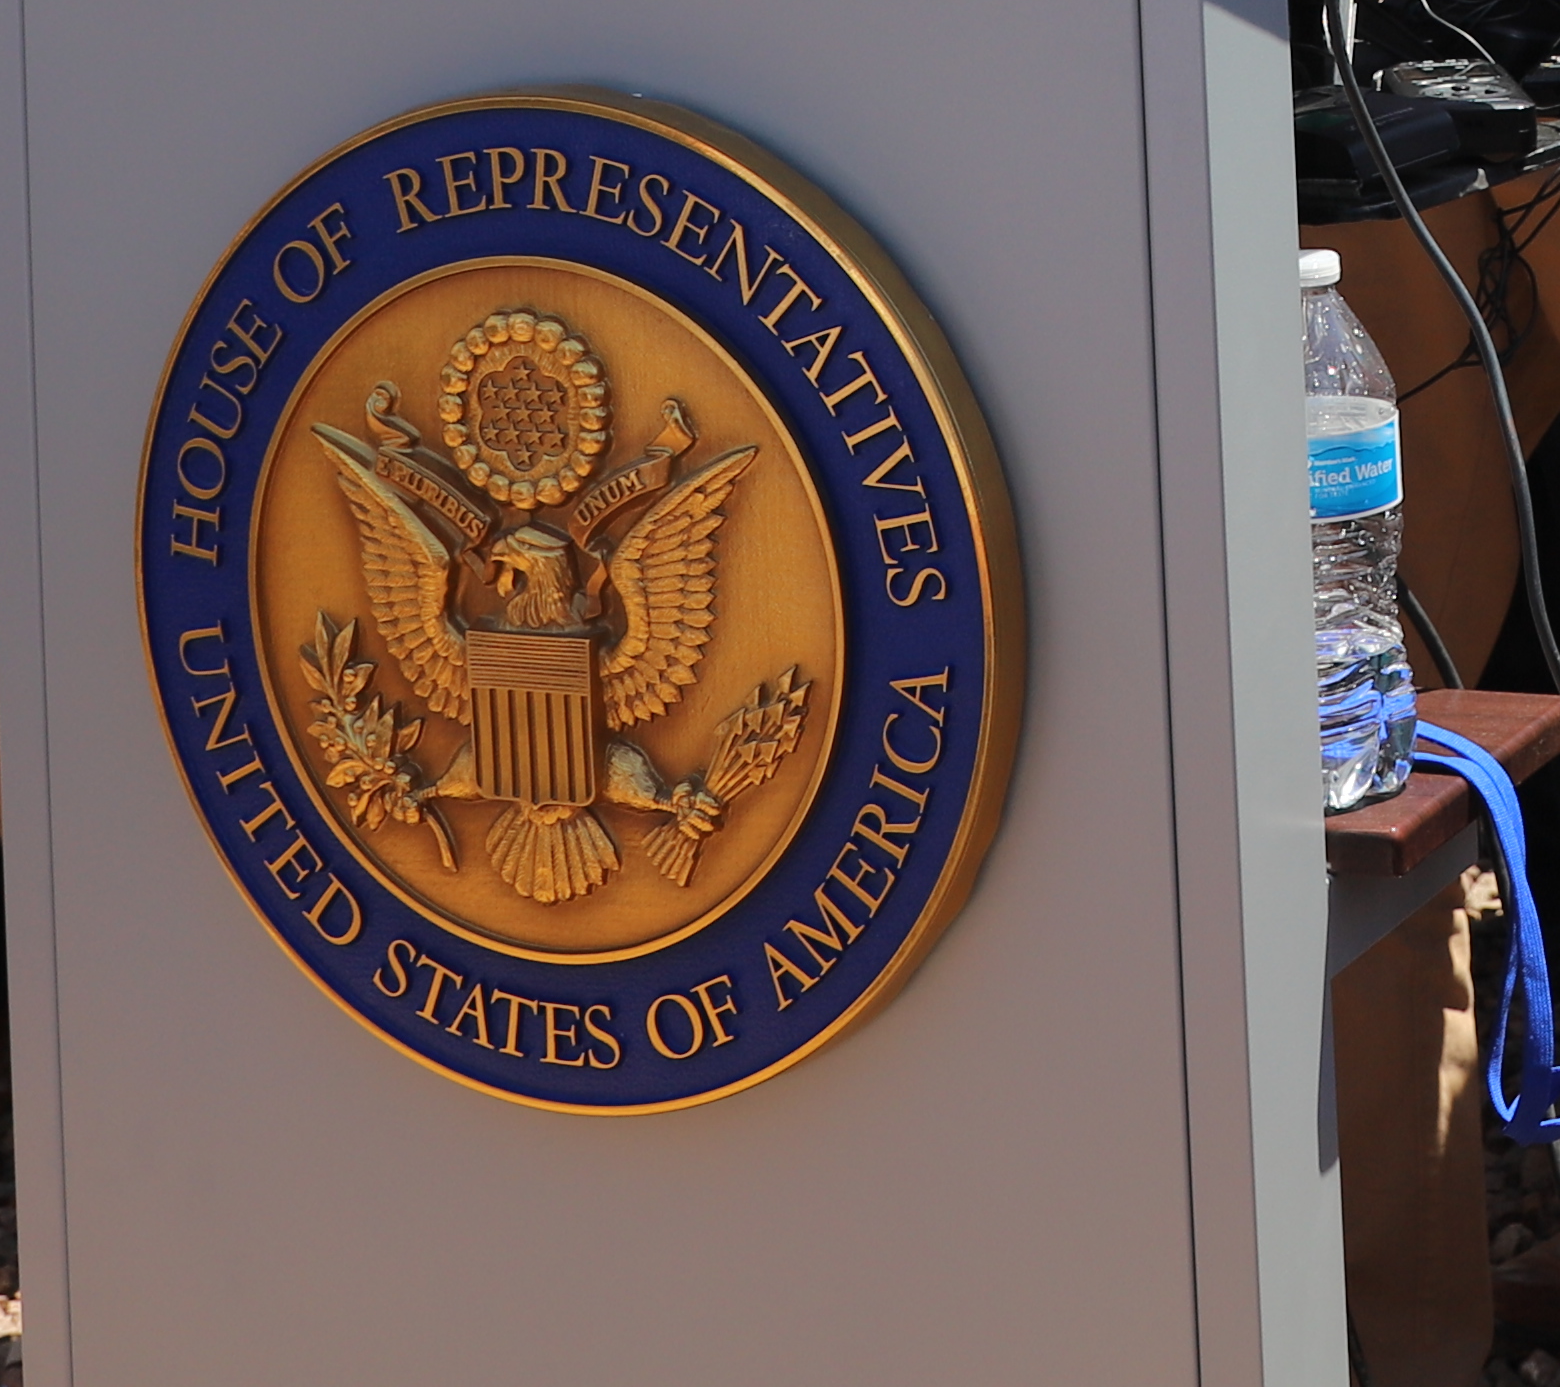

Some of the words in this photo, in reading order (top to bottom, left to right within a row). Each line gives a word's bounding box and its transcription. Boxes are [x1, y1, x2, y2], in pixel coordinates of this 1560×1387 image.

[171, 297, 282, 569] HOUSE
[271, 202, 357, 305] OF
[383, 145, 948, 611] REPRESENTATIVES
[393, 461, 487, 542] PLURIBUS
[572, 469, 645, 528] UNUM
[1308, 467, 1352, 487] ified
[1354, 457, 1394, 482] Water
[179, 619, 364, 949] UNITED
[374, 937, 622, 1072] STATES
[646, 974, 741, 1062] OF
[761, 663, 950, 1013] AMERICA
